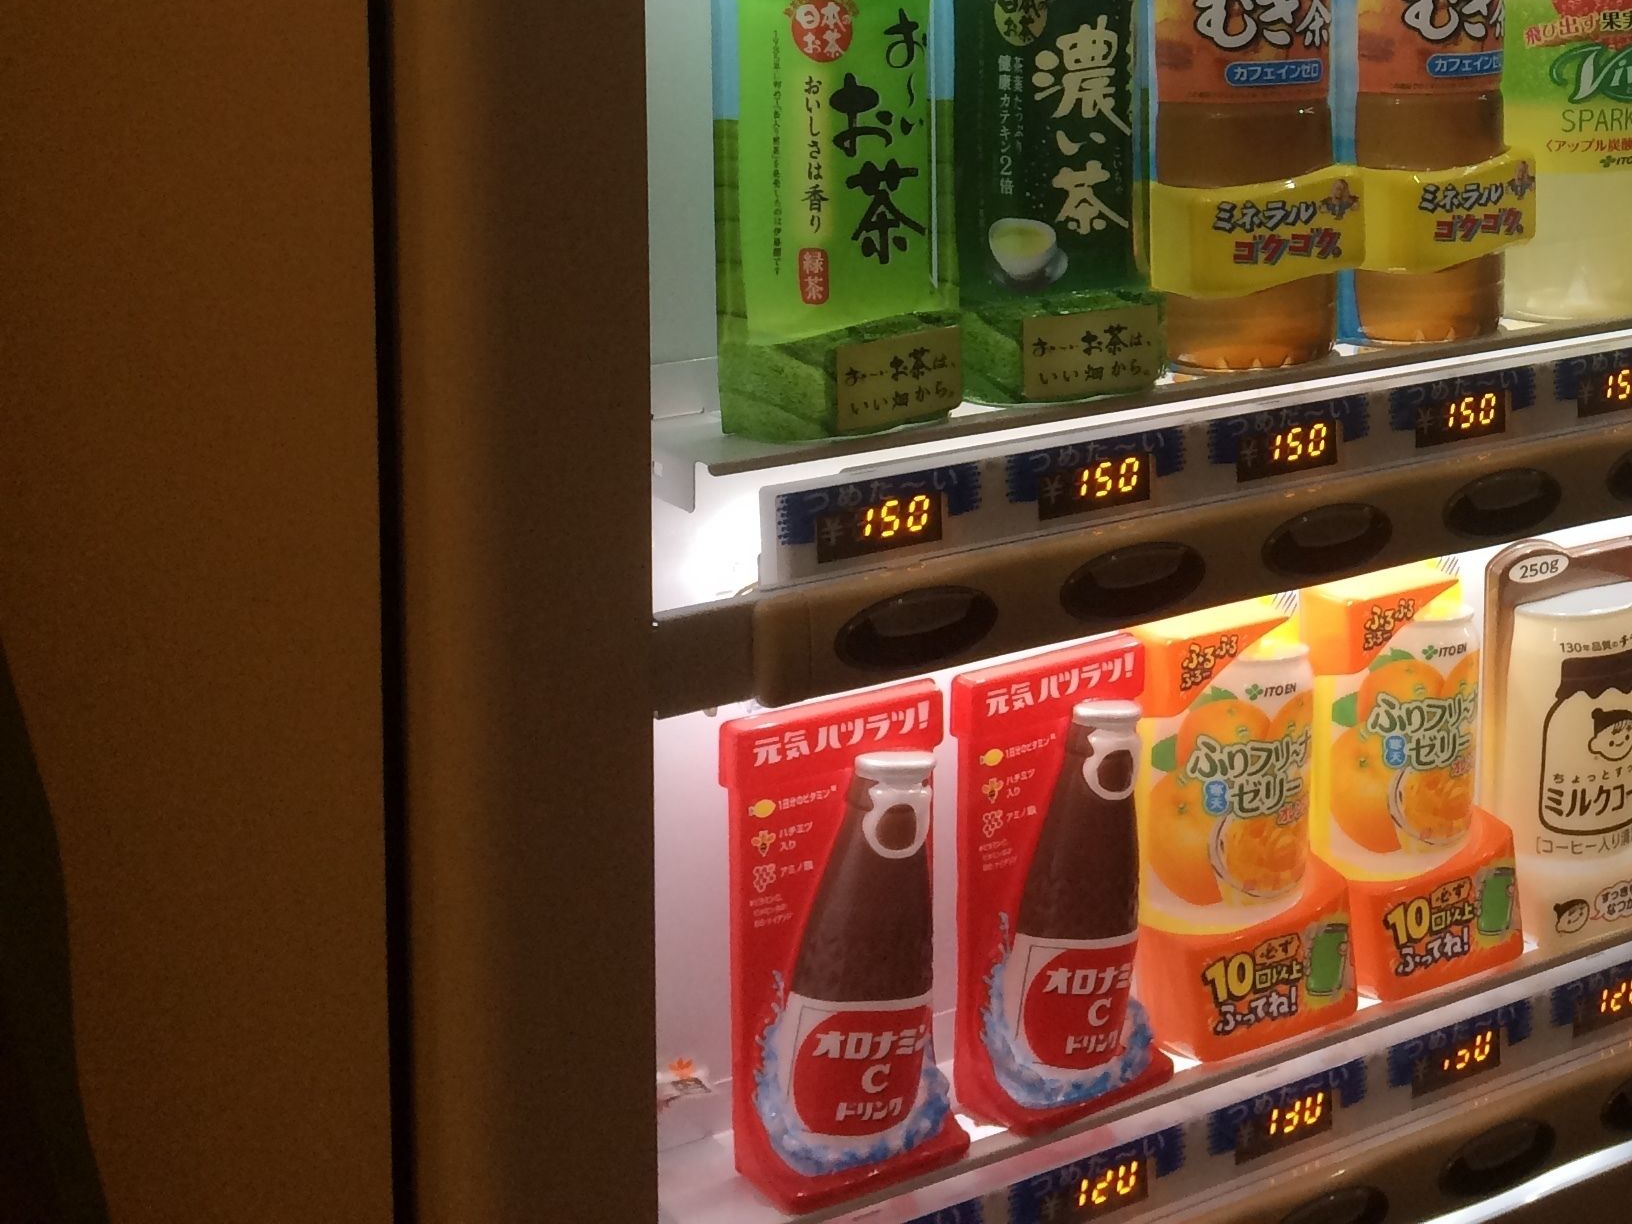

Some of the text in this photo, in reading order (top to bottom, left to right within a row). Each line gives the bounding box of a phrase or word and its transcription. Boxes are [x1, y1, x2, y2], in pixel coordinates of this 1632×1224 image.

[1232, 61, 1320, 83] カフェインゼロ
[1031, 13, 1133, 236] 濃い茶
[802, 74, 830, 235] おいしさは香り
[828, 72, 928, 265] お茶
[1418, 181, 1505, 213] ミネラル
[1212, 199, 1317, 232] ミネラル
[801, 250, 826, 302] 緑茶
[1037, 357, 1152, 385] いい畑から。
[850, 382, 957, 416] いい畑から。
[1446, 391, 1496, 430] 150
[1271, 421, 1328, 463] 150
[1078, 455, 1141, 499] 150
[861, 492, 931, 539] 150
[1519, 559, 1560, 581] 250g
[1438, 645, 1456, 658] ITO
[1263, 685, 1285, 698] ITO
[1231, 779, 1302, 814] ゼリー
[1042, 963, 1134, 994] オロナミ
[1088, 997, 1112, 1028] C
[1064, 1029, 1120, 1056] ドリンク
[861, 1063, 891, 1095] C
[834, 1096, 905, 1123] ドリンク
